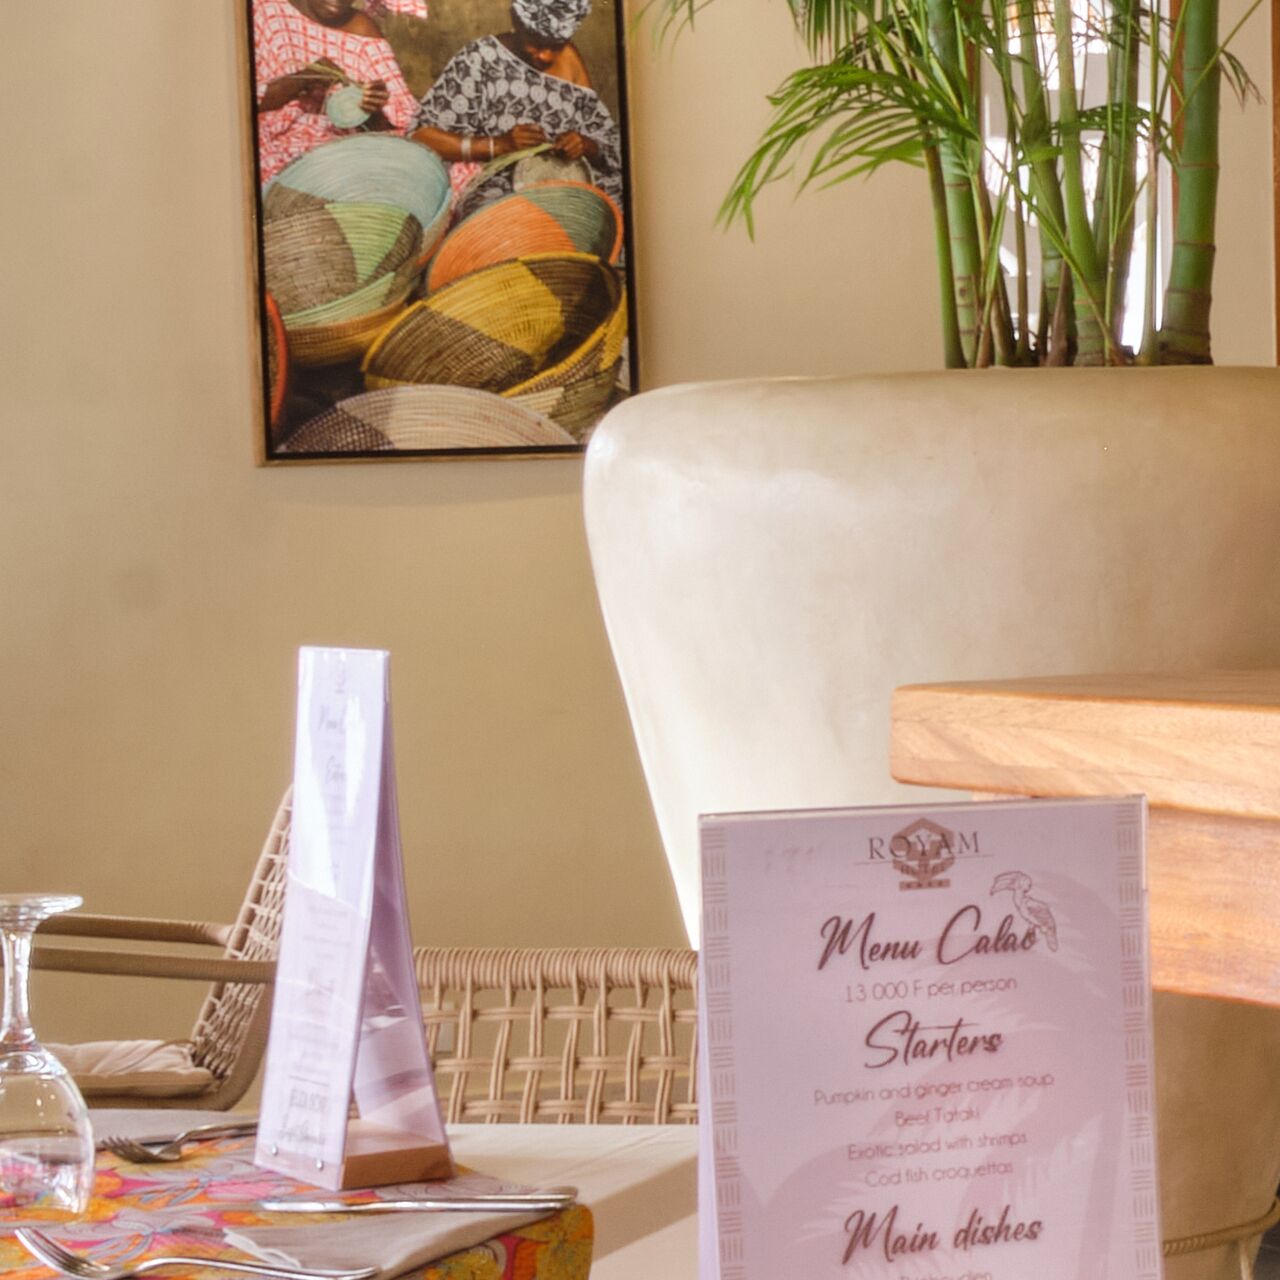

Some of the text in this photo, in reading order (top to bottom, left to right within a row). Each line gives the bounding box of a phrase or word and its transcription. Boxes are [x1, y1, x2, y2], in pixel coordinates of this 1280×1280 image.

[867, 831, 981, 860] ROYAM
[817, 904, 1037, 970] Menu Calao
[845, 978, 1017, 1004] 13 000 F per person
[864, 1010, 1004, 1069] Starters
[813, 1073, 1055, 1107] Pumpkin and ginger cream soup
[895, 1109, 930, 1128] Beef
[865, 1171, 901, 1188] Cod
[842, 1205, 1043, 1266] Main dishes
